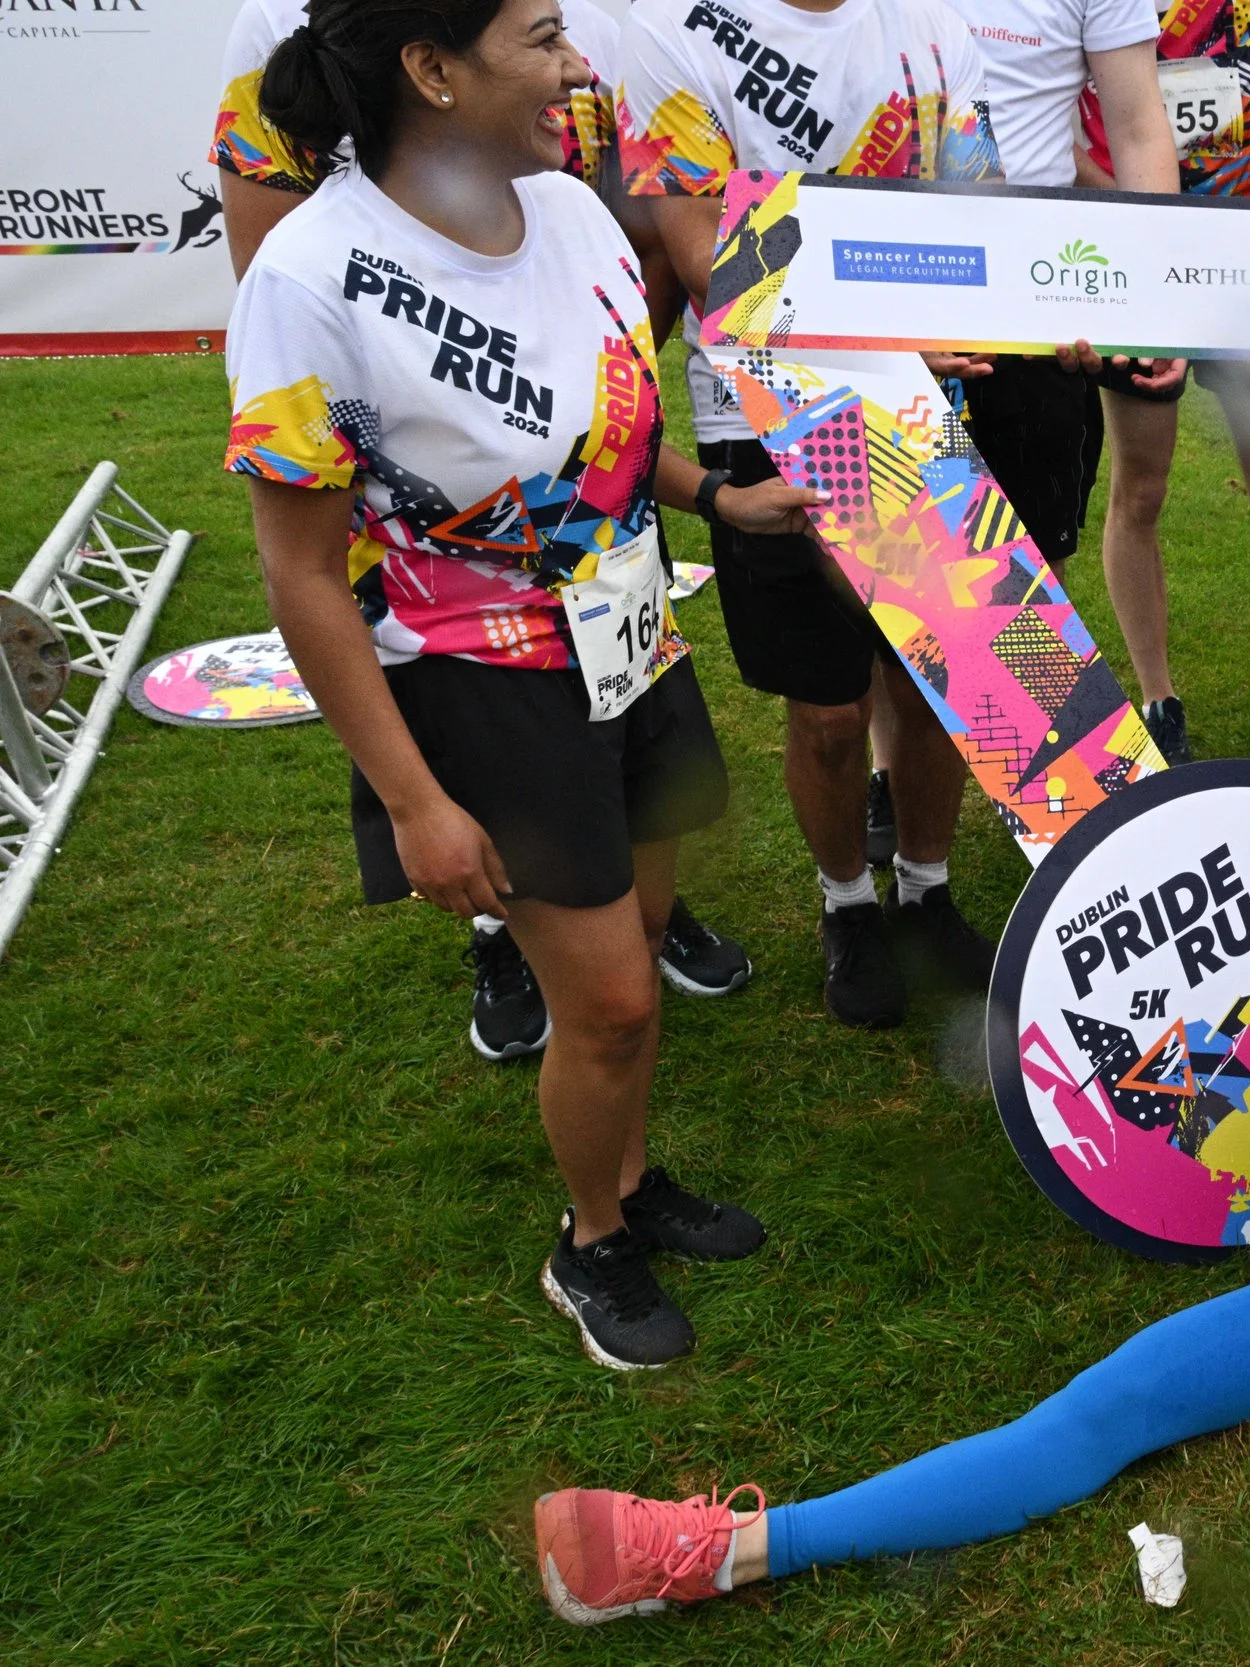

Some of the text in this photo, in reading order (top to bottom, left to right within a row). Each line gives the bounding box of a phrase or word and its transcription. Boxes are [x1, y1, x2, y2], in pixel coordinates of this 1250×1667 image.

[7, 26, 81, 39] CAPITAL
[981, 26, 1042, 47] Different
[684, 5, 818, 99] PRIDE
[734, 69, 834, 152] RUN
[1164, 99, 1218, 133] 55
[777, 134, 814, 164] 2024
[0, 213, 169, 238] RUNNERS
[843, 249, 977, 266] Spencer Lennox
[850, 264, 973, 277] LEGAL RECRUITMENT
[1030, 260, 1127, 295] Origin
[344, 259, 518, 369] PRIDE
[1035, 295, 1128, 305] ENTERPRISES PLC
[430, 341, 553, 423] RUN
[602, 335, 637, 448] PRIDE
[503, 411, 550, 439] 2024
[597, 669, 628, 696] PRIDE
[616, 676, 633, 698] RUN
[1055, 885, 1129, 946] DUBLIN
[1061, 842, 1244, 1001] PRIDE
[1128, 989, 1171, 1020] 5K
